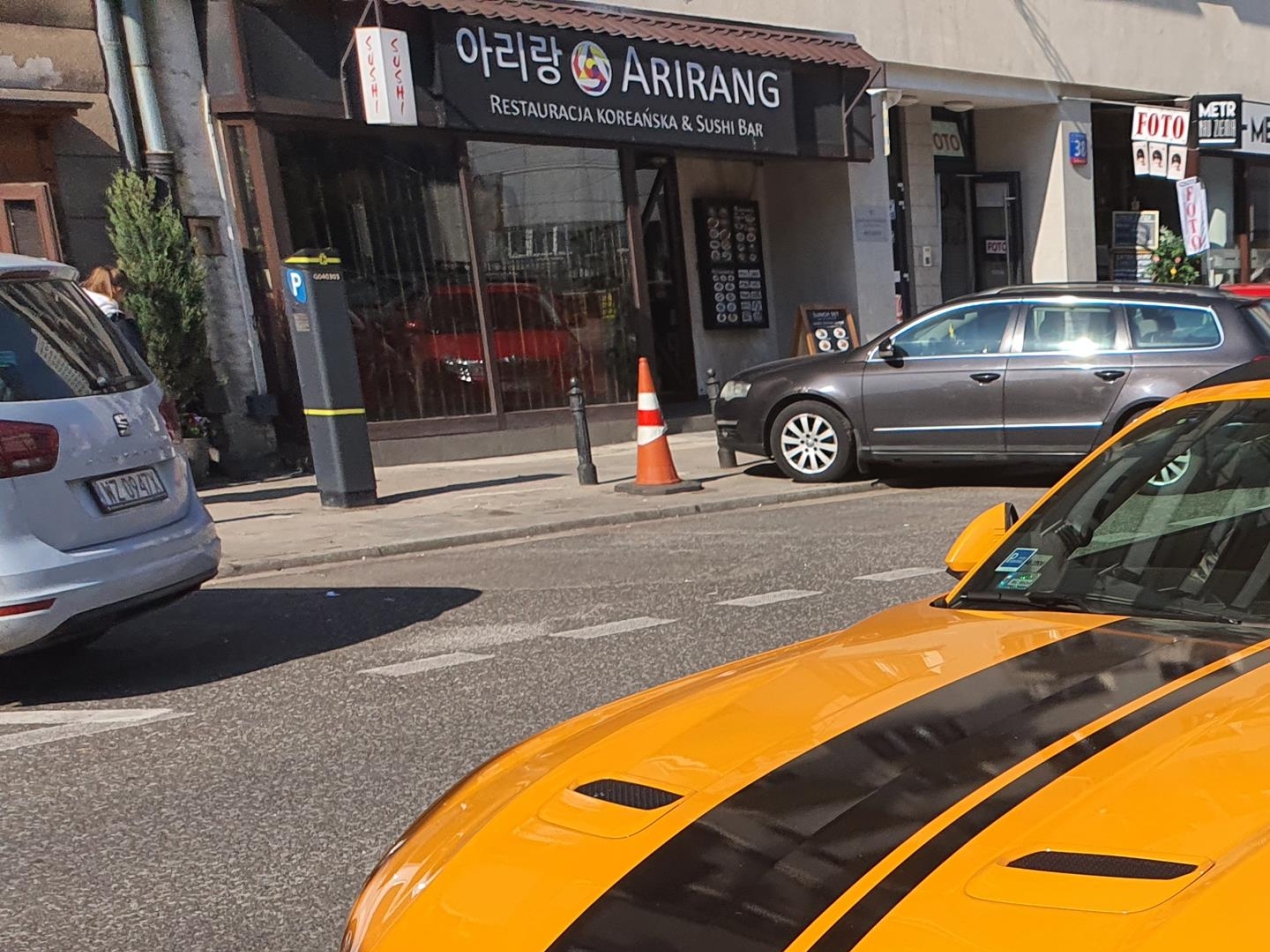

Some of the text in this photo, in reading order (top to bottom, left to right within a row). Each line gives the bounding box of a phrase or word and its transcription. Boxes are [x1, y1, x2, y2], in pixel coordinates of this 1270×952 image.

[365, 35, 380, 113] SUSHI
[390, 37, 405, 115] SUSHI
[456, 26, 563, 85] 아리랑
[621, 45, 781, 108] ARIRANG
[490, 94, 764, 138] RESTAURACJA KOREAŃSKA & SUSHI BAR
[1137, 111, 1185, 139] FOTO
[1198, 101, 1236, 118] METR
[933, 133, 960, 150] OTO
[1074, 139, 1086, 157] 38
[1185, 186, 1204, 251] FOTO
[290, 272, 302, 297] P
